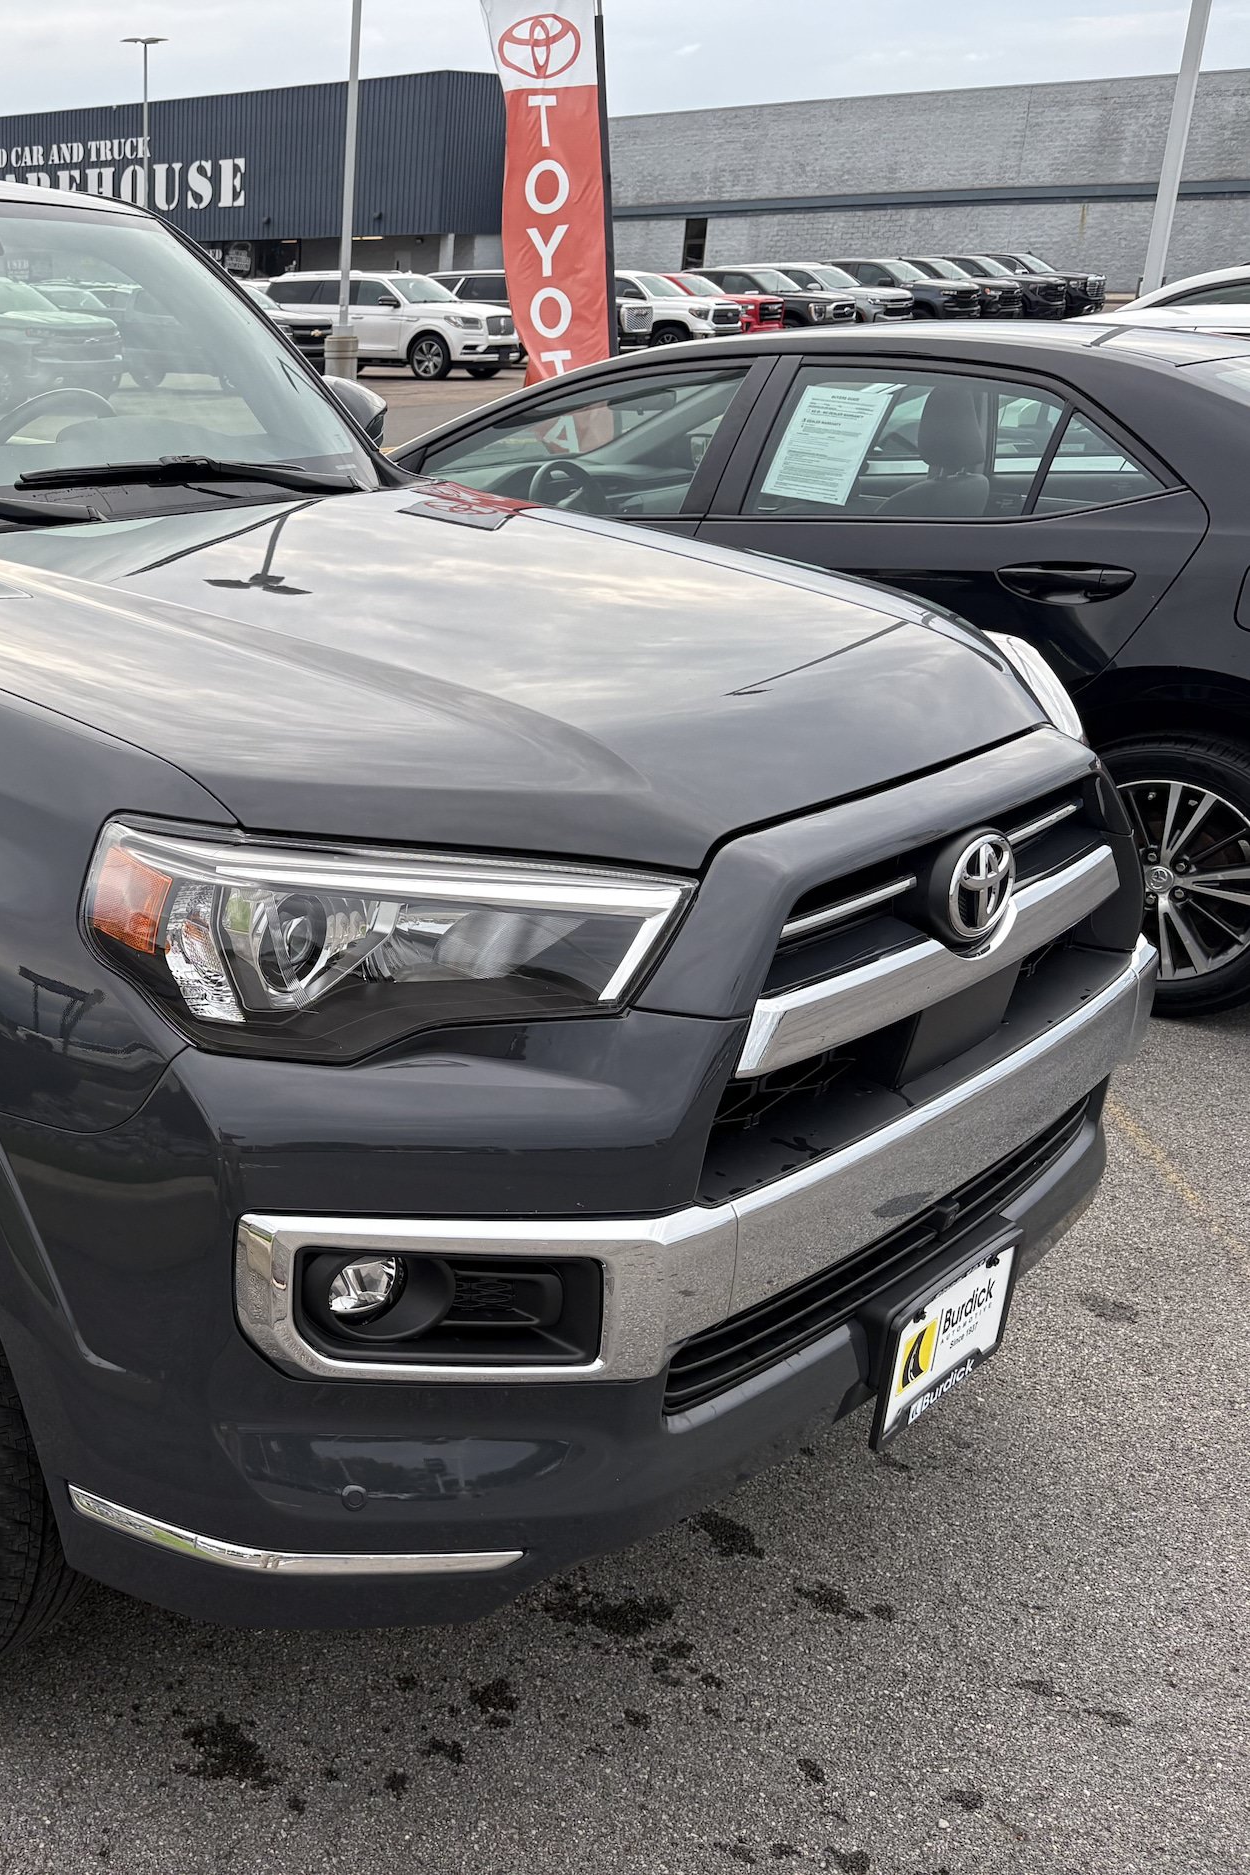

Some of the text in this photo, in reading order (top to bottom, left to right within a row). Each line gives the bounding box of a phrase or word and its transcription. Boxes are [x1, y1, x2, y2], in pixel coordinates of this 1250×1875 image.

[10, 145, 45, 168] CAR
[49, 142, 85, 165] AND
[87, 136, 151, 162] TRUCK
[942, 1277, 996, 1335] Burdick
[921, 1359, 975, 1412] Burdick
